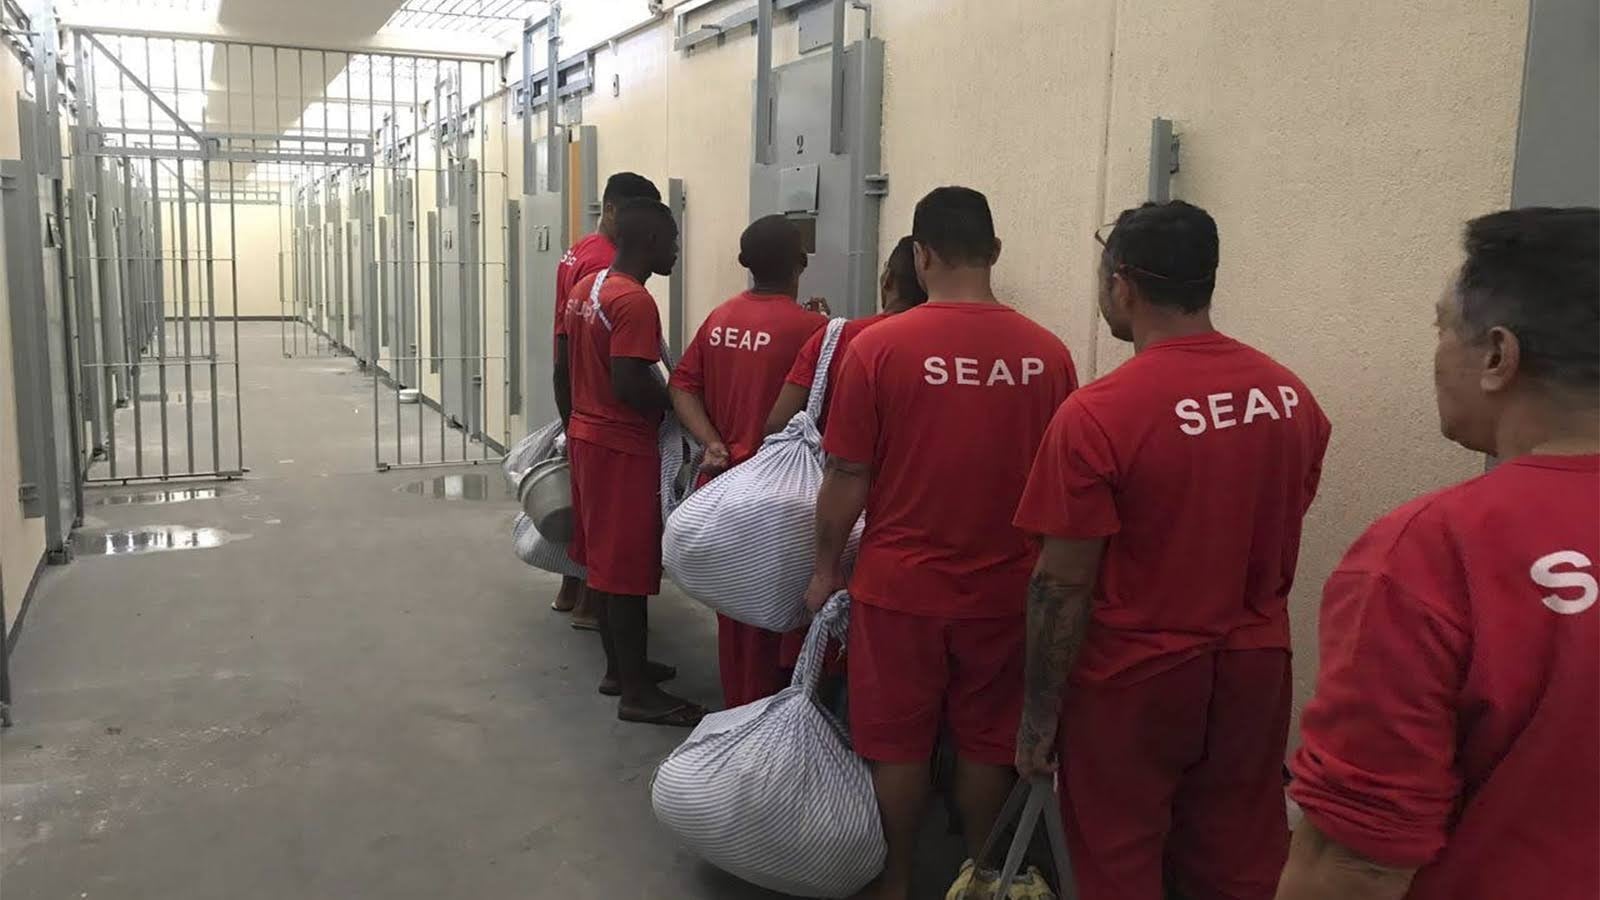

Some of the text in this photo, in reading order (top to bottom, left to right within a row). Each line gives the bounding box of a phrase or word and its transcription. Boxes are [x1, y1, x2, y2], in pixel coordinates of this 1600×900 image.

[796, 135, 804, 155] 2
[709, 326, 771, 352] SEAP
[923, 356, 1045, 386] SEAP
[1175, 385, 1299, 436] SEAP
